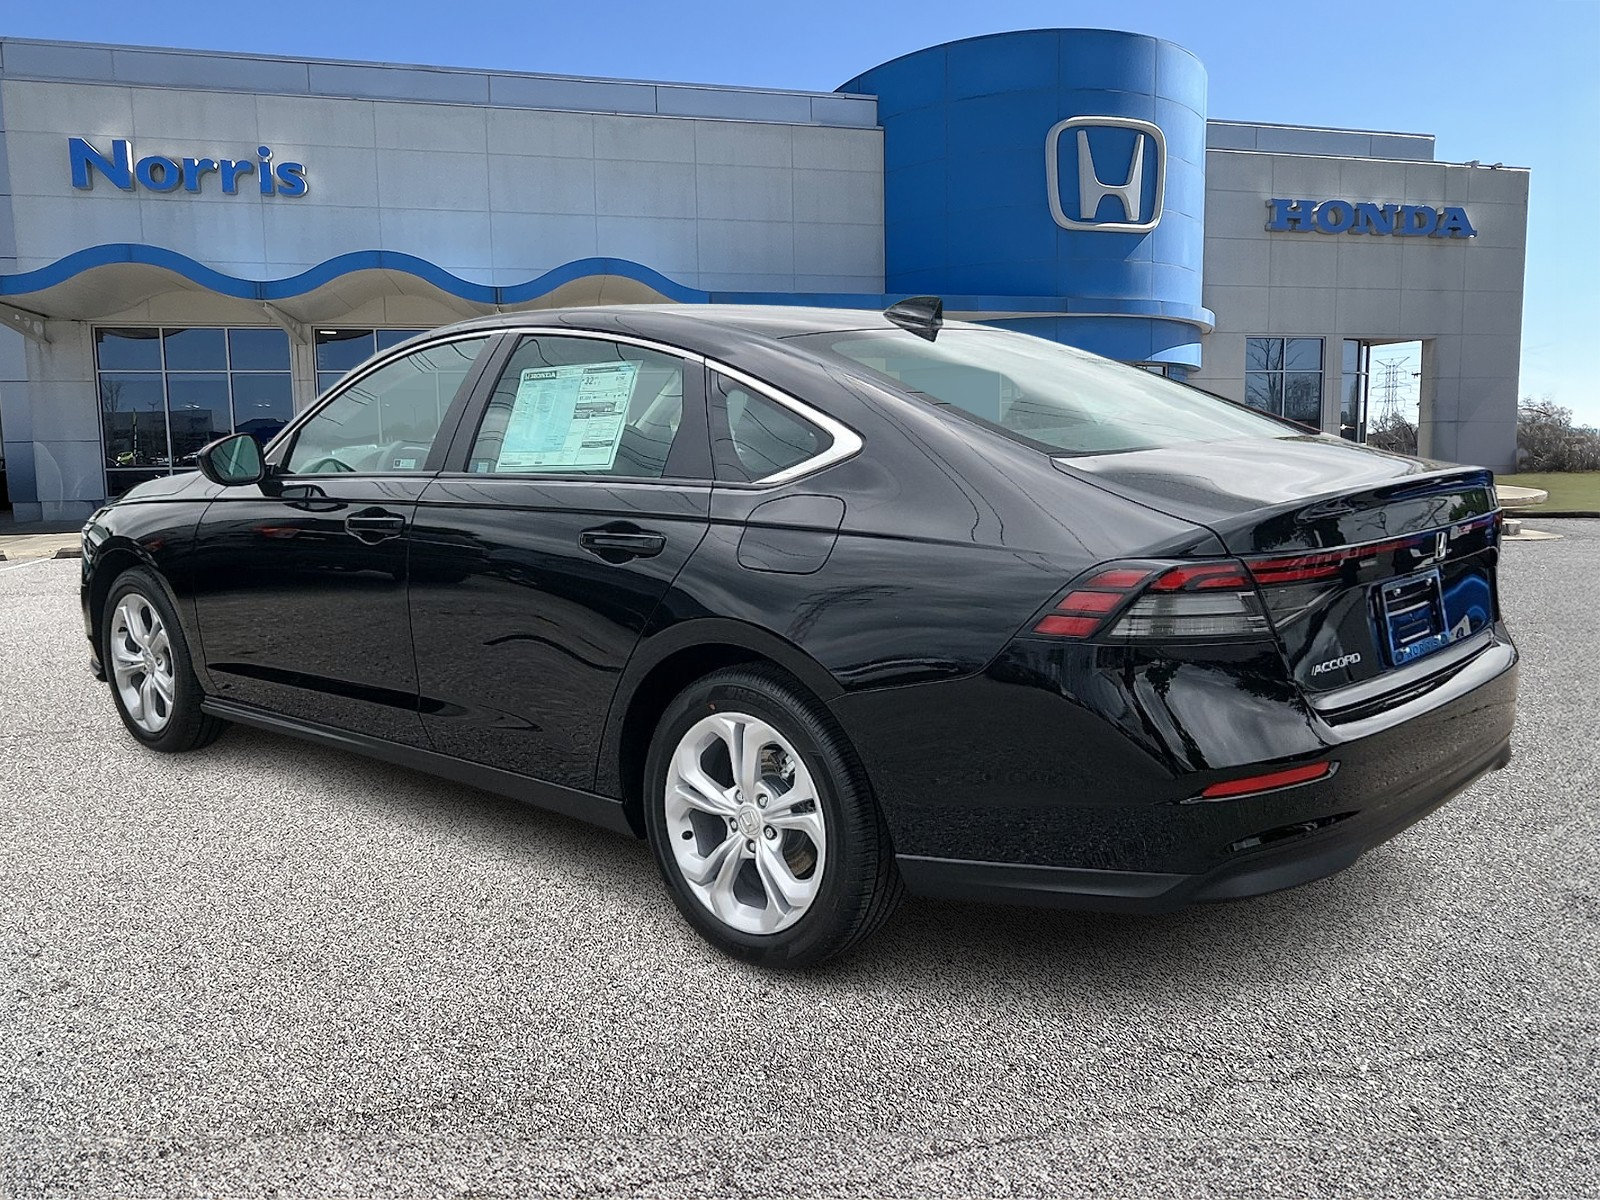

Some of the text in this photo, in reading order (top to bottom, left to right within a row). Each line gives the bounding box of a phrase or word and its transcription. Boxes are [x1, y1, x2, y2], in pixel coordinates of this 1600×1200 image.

[68, 137, 309, 197] Norris
[1265, 197, 1478, 239] HONDA
[1312, 652, 1361, 676] ACCORD
